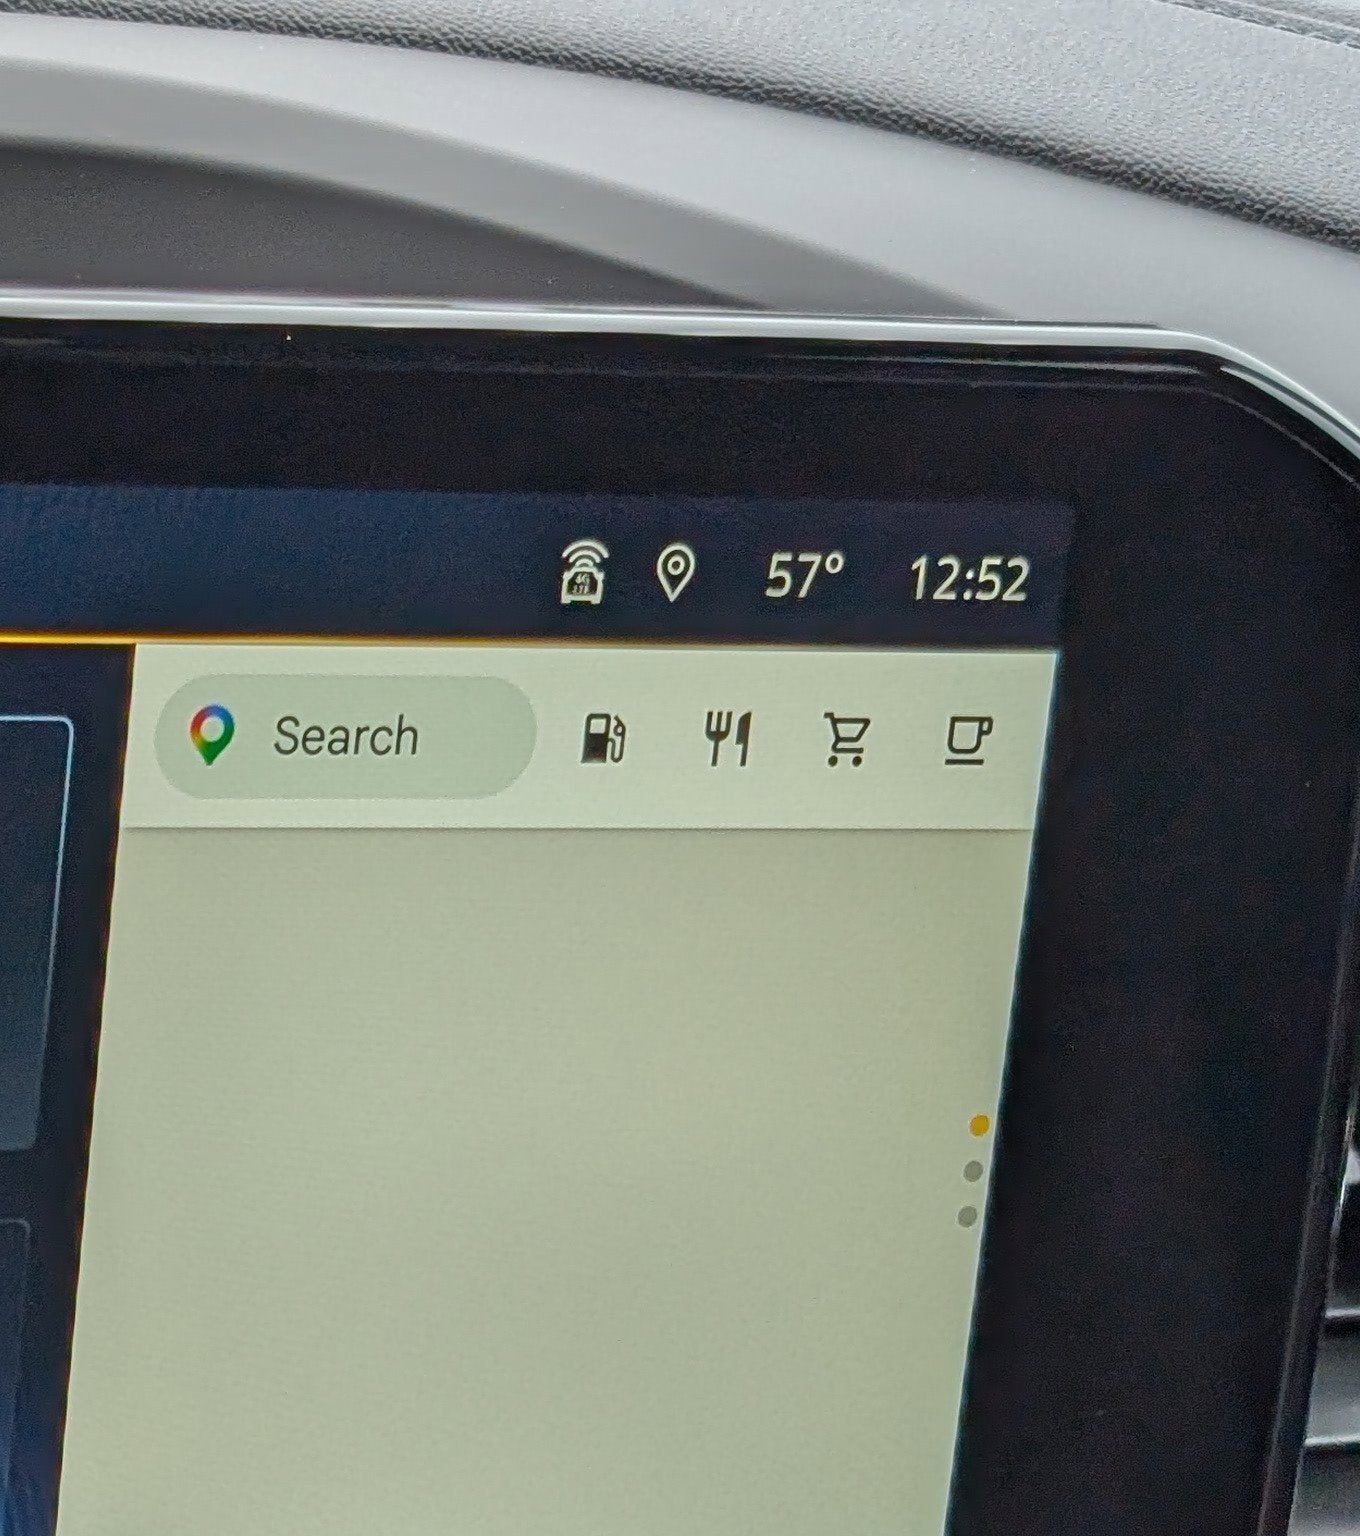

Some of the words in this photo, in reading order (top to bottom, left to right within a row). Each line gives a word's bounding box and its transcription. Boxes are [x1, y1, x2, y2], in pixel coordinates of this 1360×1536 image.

[765, 551, 845, 599] 57°
[910, 555, 1031, 602] 12:52
[273, 713, 420, 758] Search
